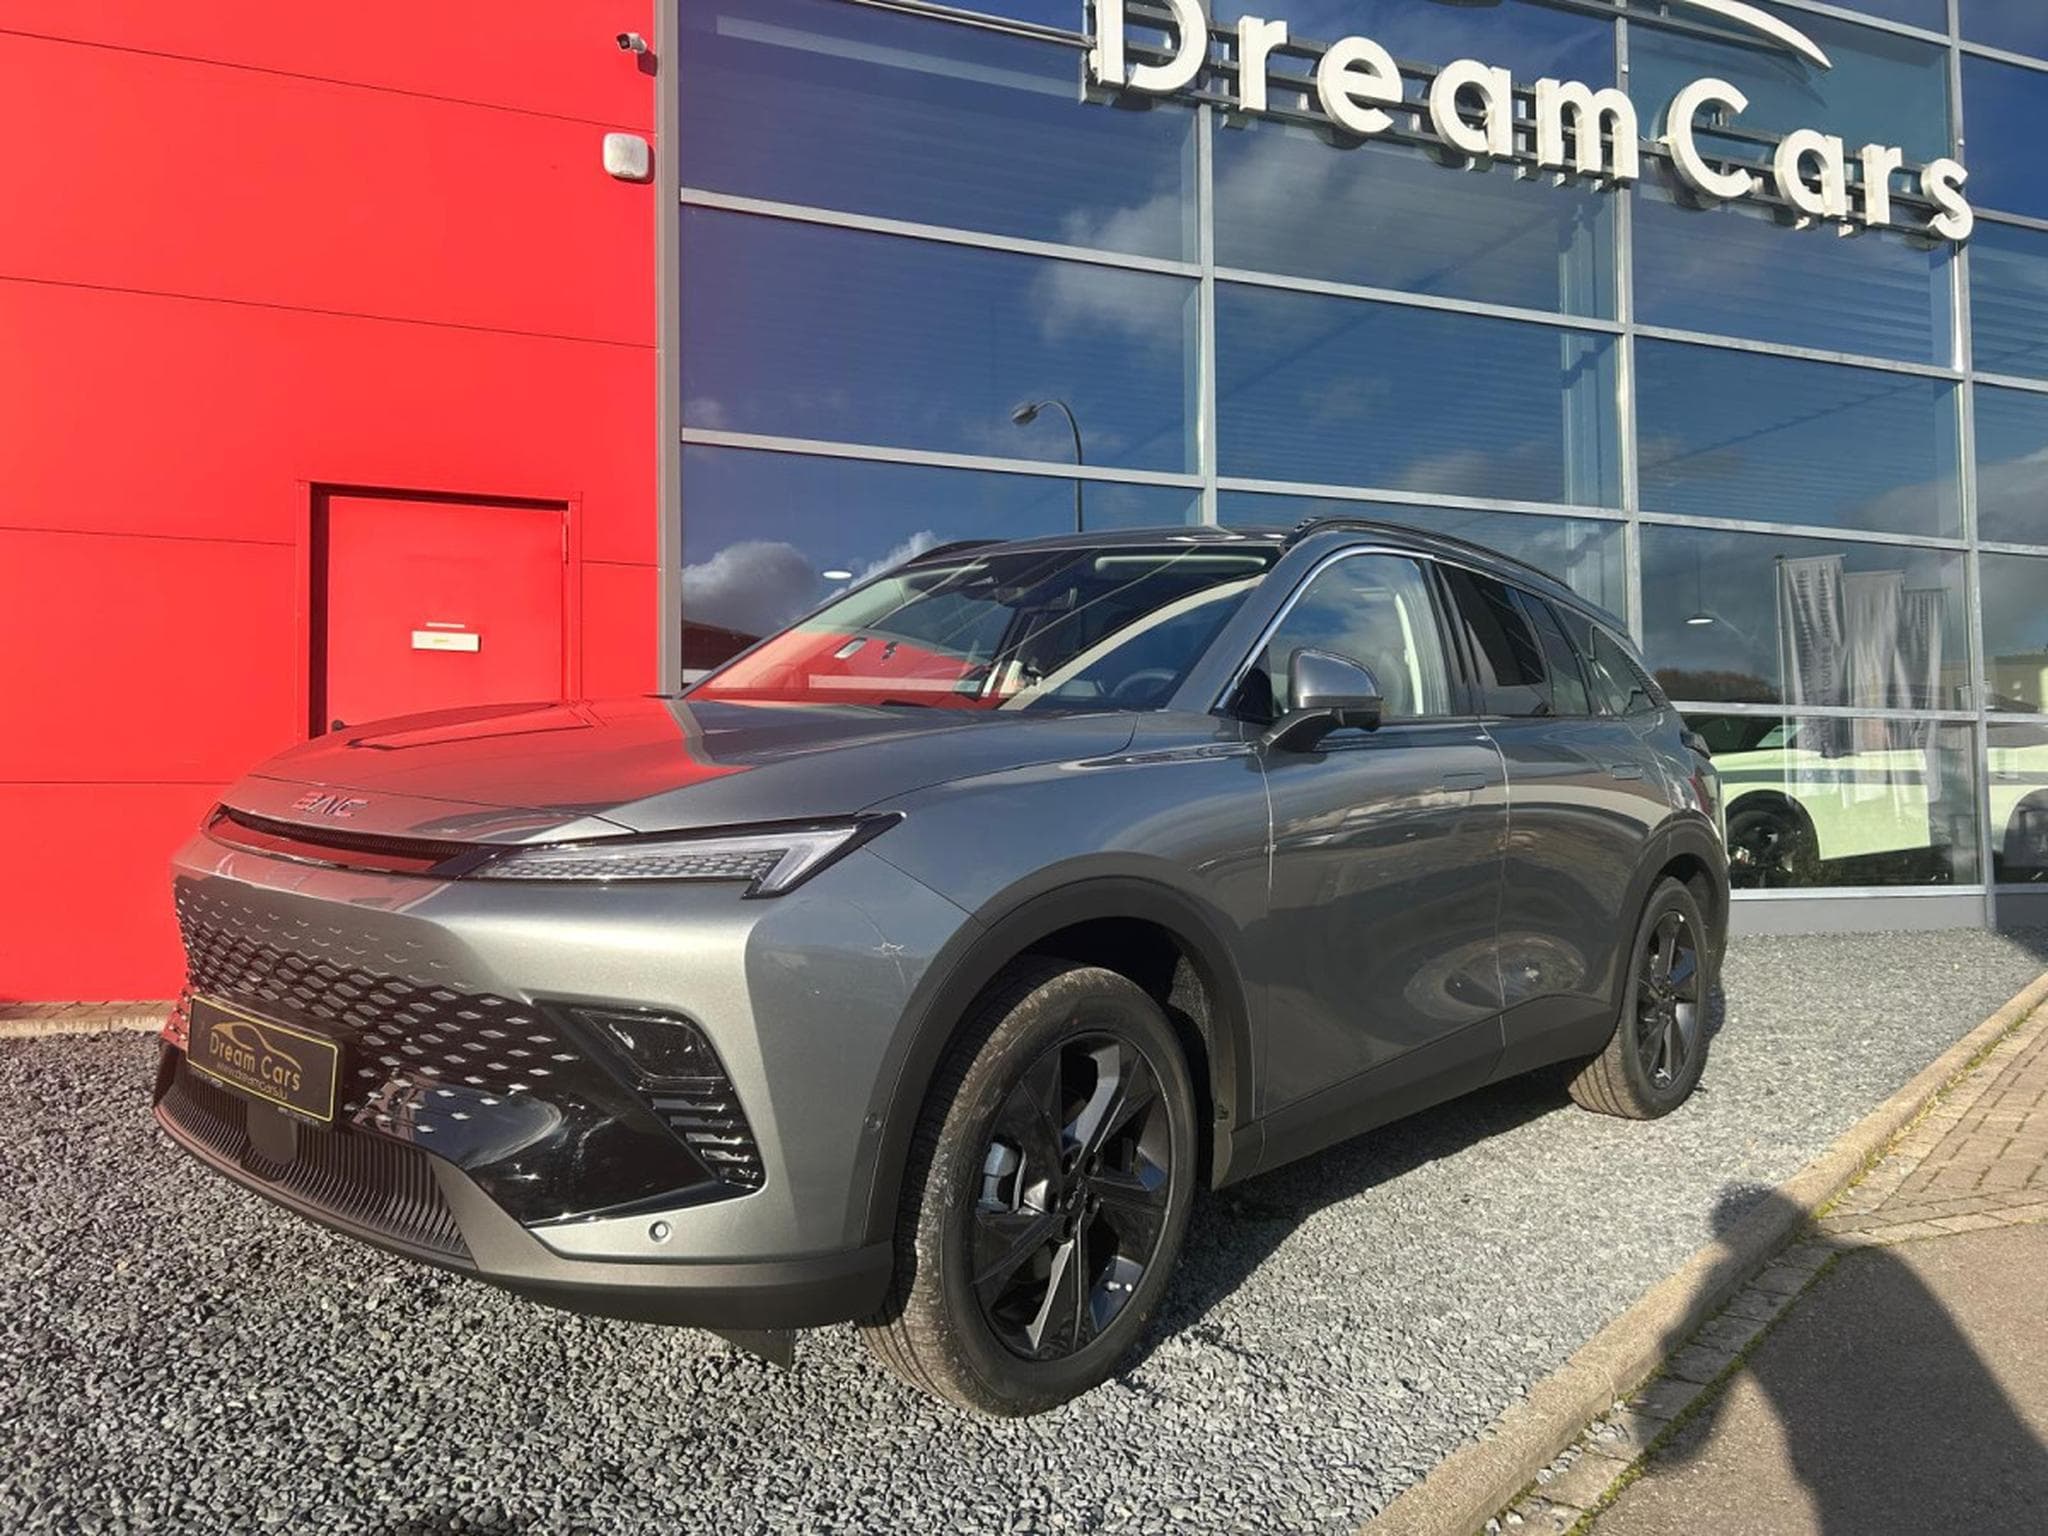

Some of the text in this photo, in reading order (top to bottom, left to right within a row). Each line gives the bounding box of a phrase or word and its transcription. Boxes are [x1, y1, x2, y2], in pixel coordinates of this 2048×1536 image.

[1092, 0, 1974, 242] Dream Cars
[209, 1031, 256, 1072] Dream
[260, 1056, 301, 1091] Cars
